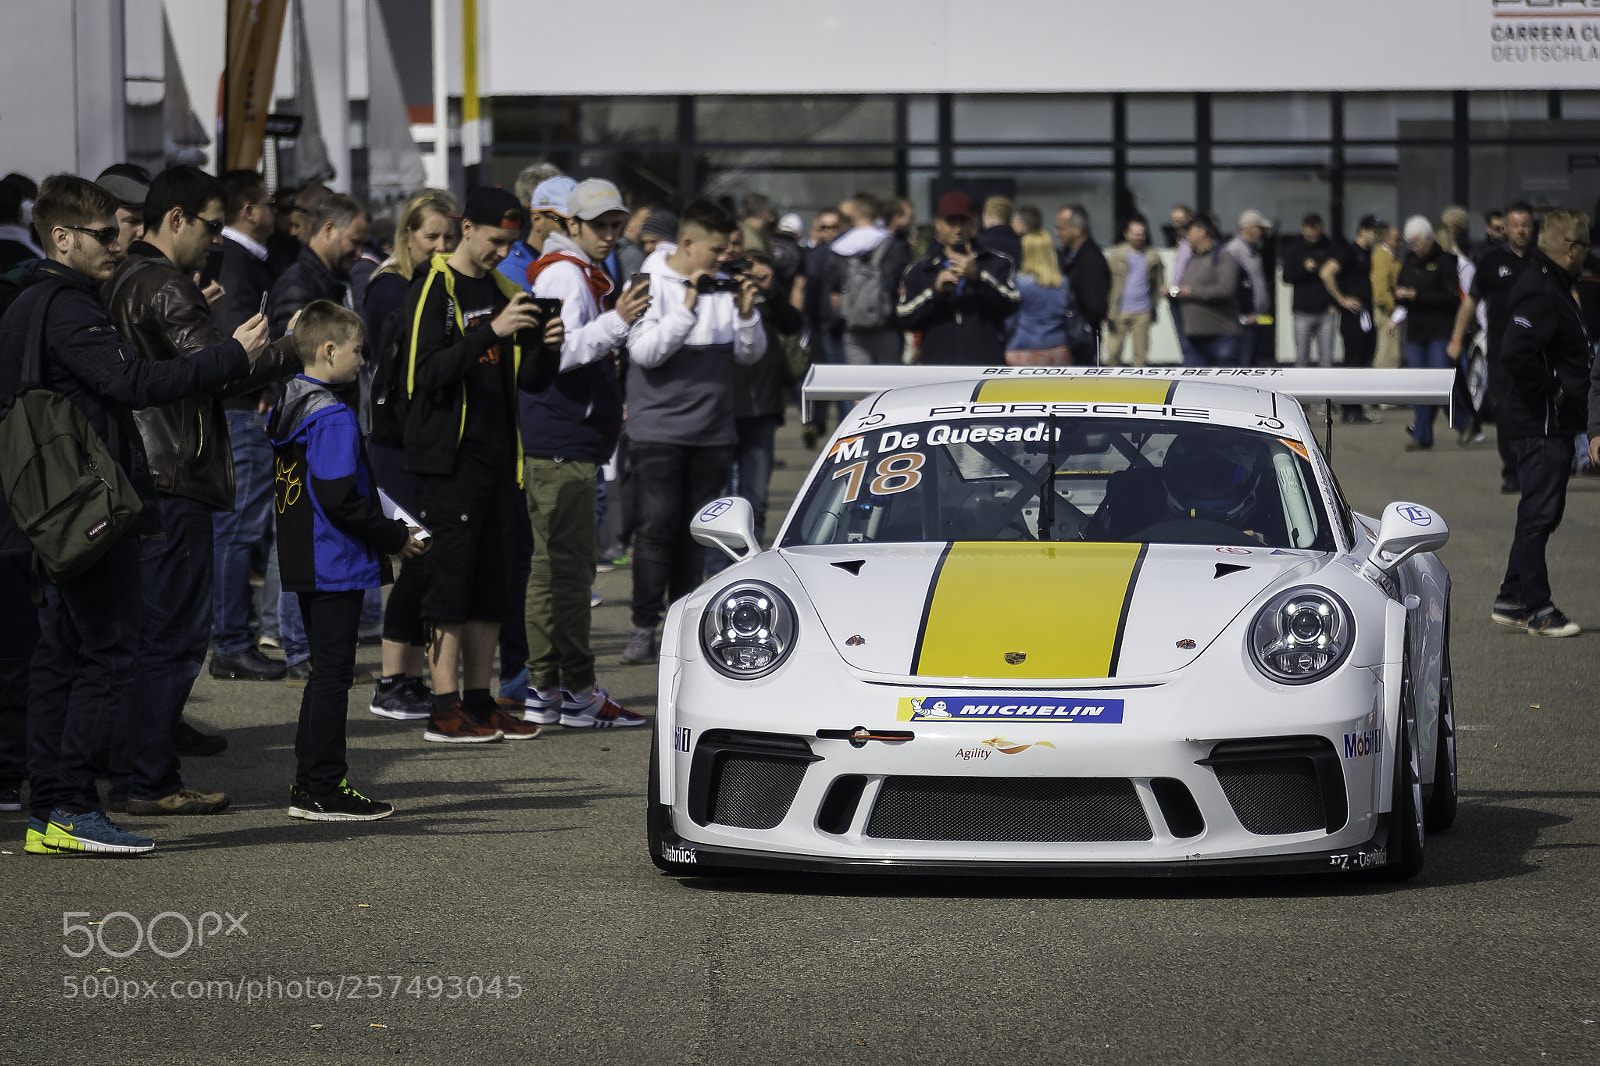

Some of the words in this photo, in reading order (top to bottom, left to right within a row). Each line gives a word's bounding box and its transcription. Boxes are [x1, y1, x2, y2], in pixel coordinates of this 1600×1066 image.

[1491, 23, 1577, 42] CARRERA
[982, 367, 1014, 376] BE
[1018, 368, 1078, 377] COOL.
[1083, 368, 1114, 377] BE
[1118, 368, 1176, 378] FAST.
[1181, 369, 1213, 377] BE
[1216, 369, 1284, 378] FIRST.
[929, 404, 1210, 419] PORSCHE
[834, 439, 870, 464] M.
[877, 430, 919, 454] De
[926, 422, 1062, 447] Quesada
[831, 452, 926, 504] 18
[959, 704, 1105, 716] MICHELIN
[955, 748, 991, 760] Agility
